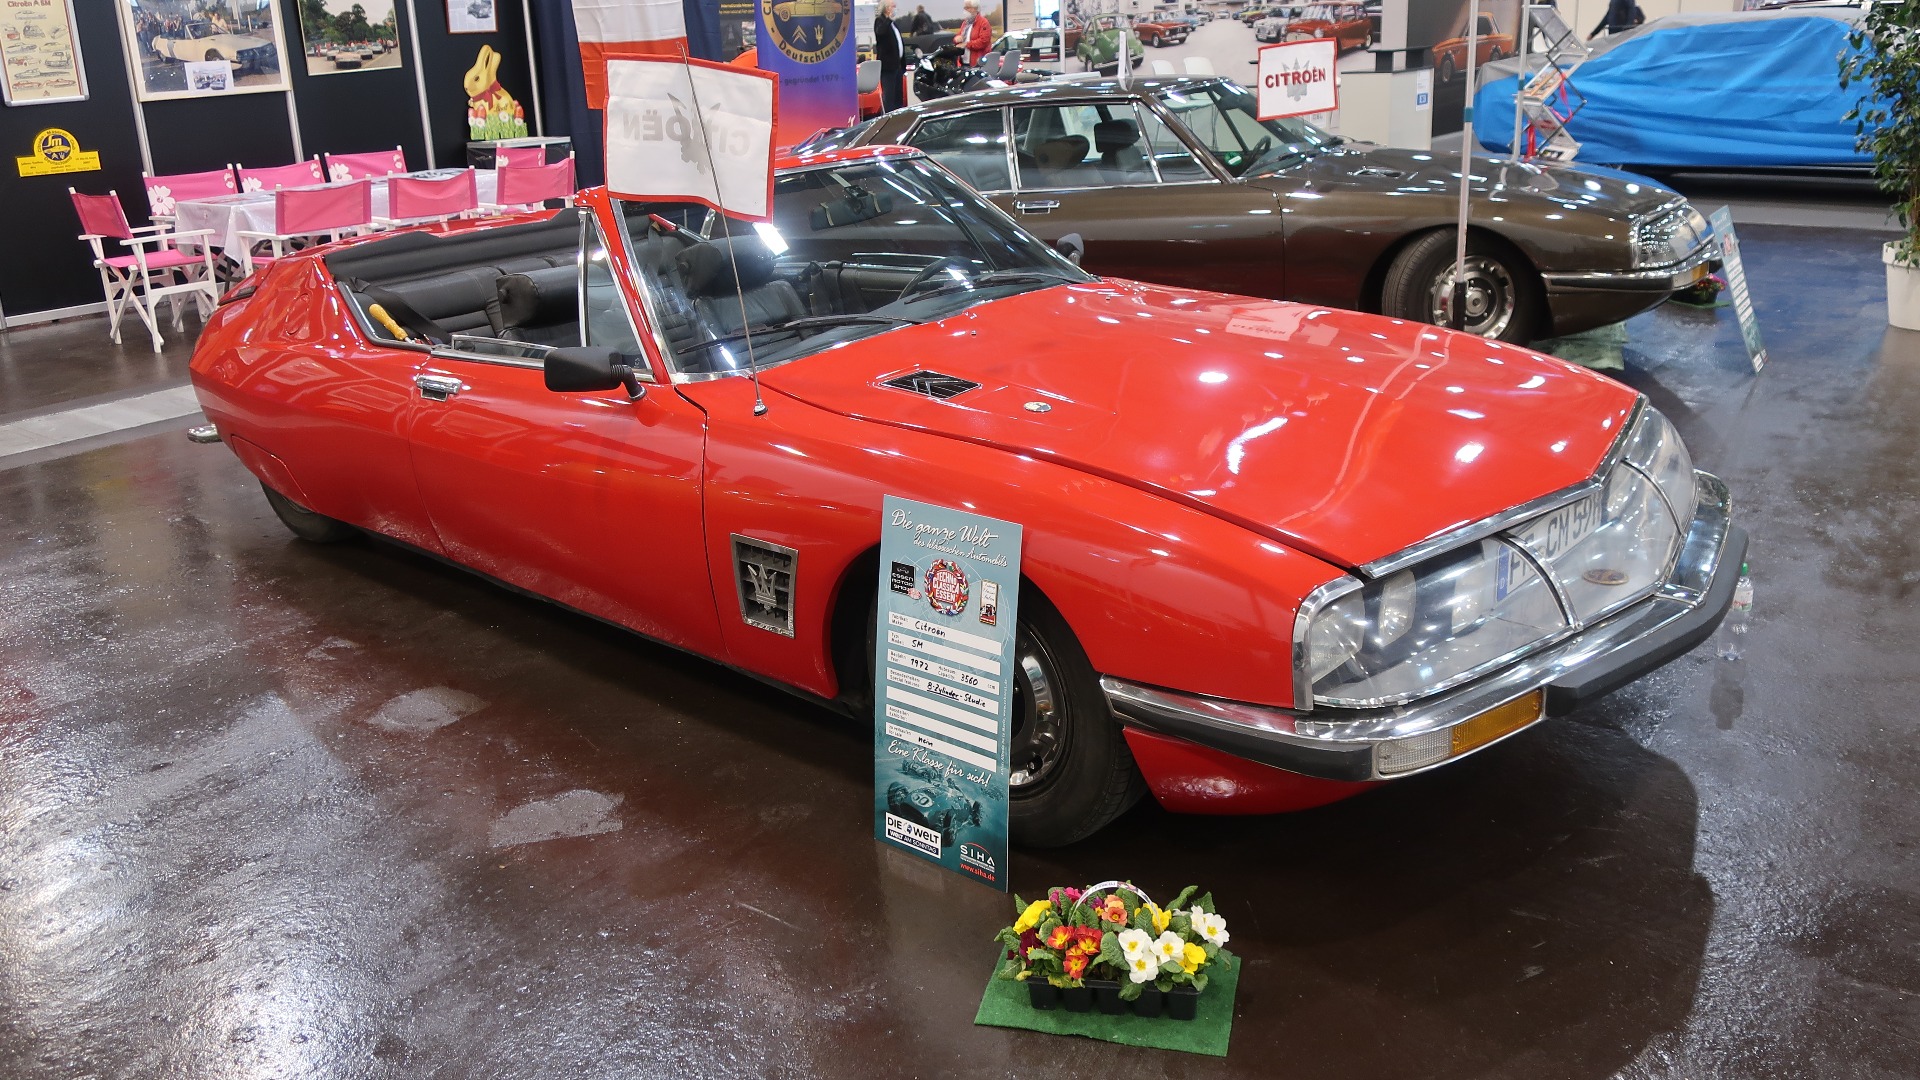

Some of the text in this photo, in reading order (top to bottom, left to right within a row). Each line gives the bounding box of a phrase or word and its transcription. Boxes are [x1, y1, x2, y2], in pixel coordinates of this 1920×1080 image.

[778, 39, 842, 63] Deutschland
[1264, 66, 1327, 89] CITROËN
[891, 508, 999, 548] Die ganze Welt
[1546, 513, 1570, 555] CM
[913, 535, 925, 548] des
[966, 547, 1008, 567] Automobils
[932, 577, 960, 594] CLASSICA
[936, 571, 957, 585] TECHNO
[935, 591, 956, 602] ESSEN
[914, 620, 946, 638] Citroën
[911, 639, 924, 649] SM
[910, 658, 929, 671] 1972
[960, 673, 979, 686] 3560
[888, 740, 992, 788] Eine Klasse für sich!
[887, 816, 903, 831] DIE
[903, 834, 912, 844] AM
[912, 837, 938, 854] SONNTAG
[960, 844, 996, 867] SIHA
[960, 863, 996, 882] www.siha.de
